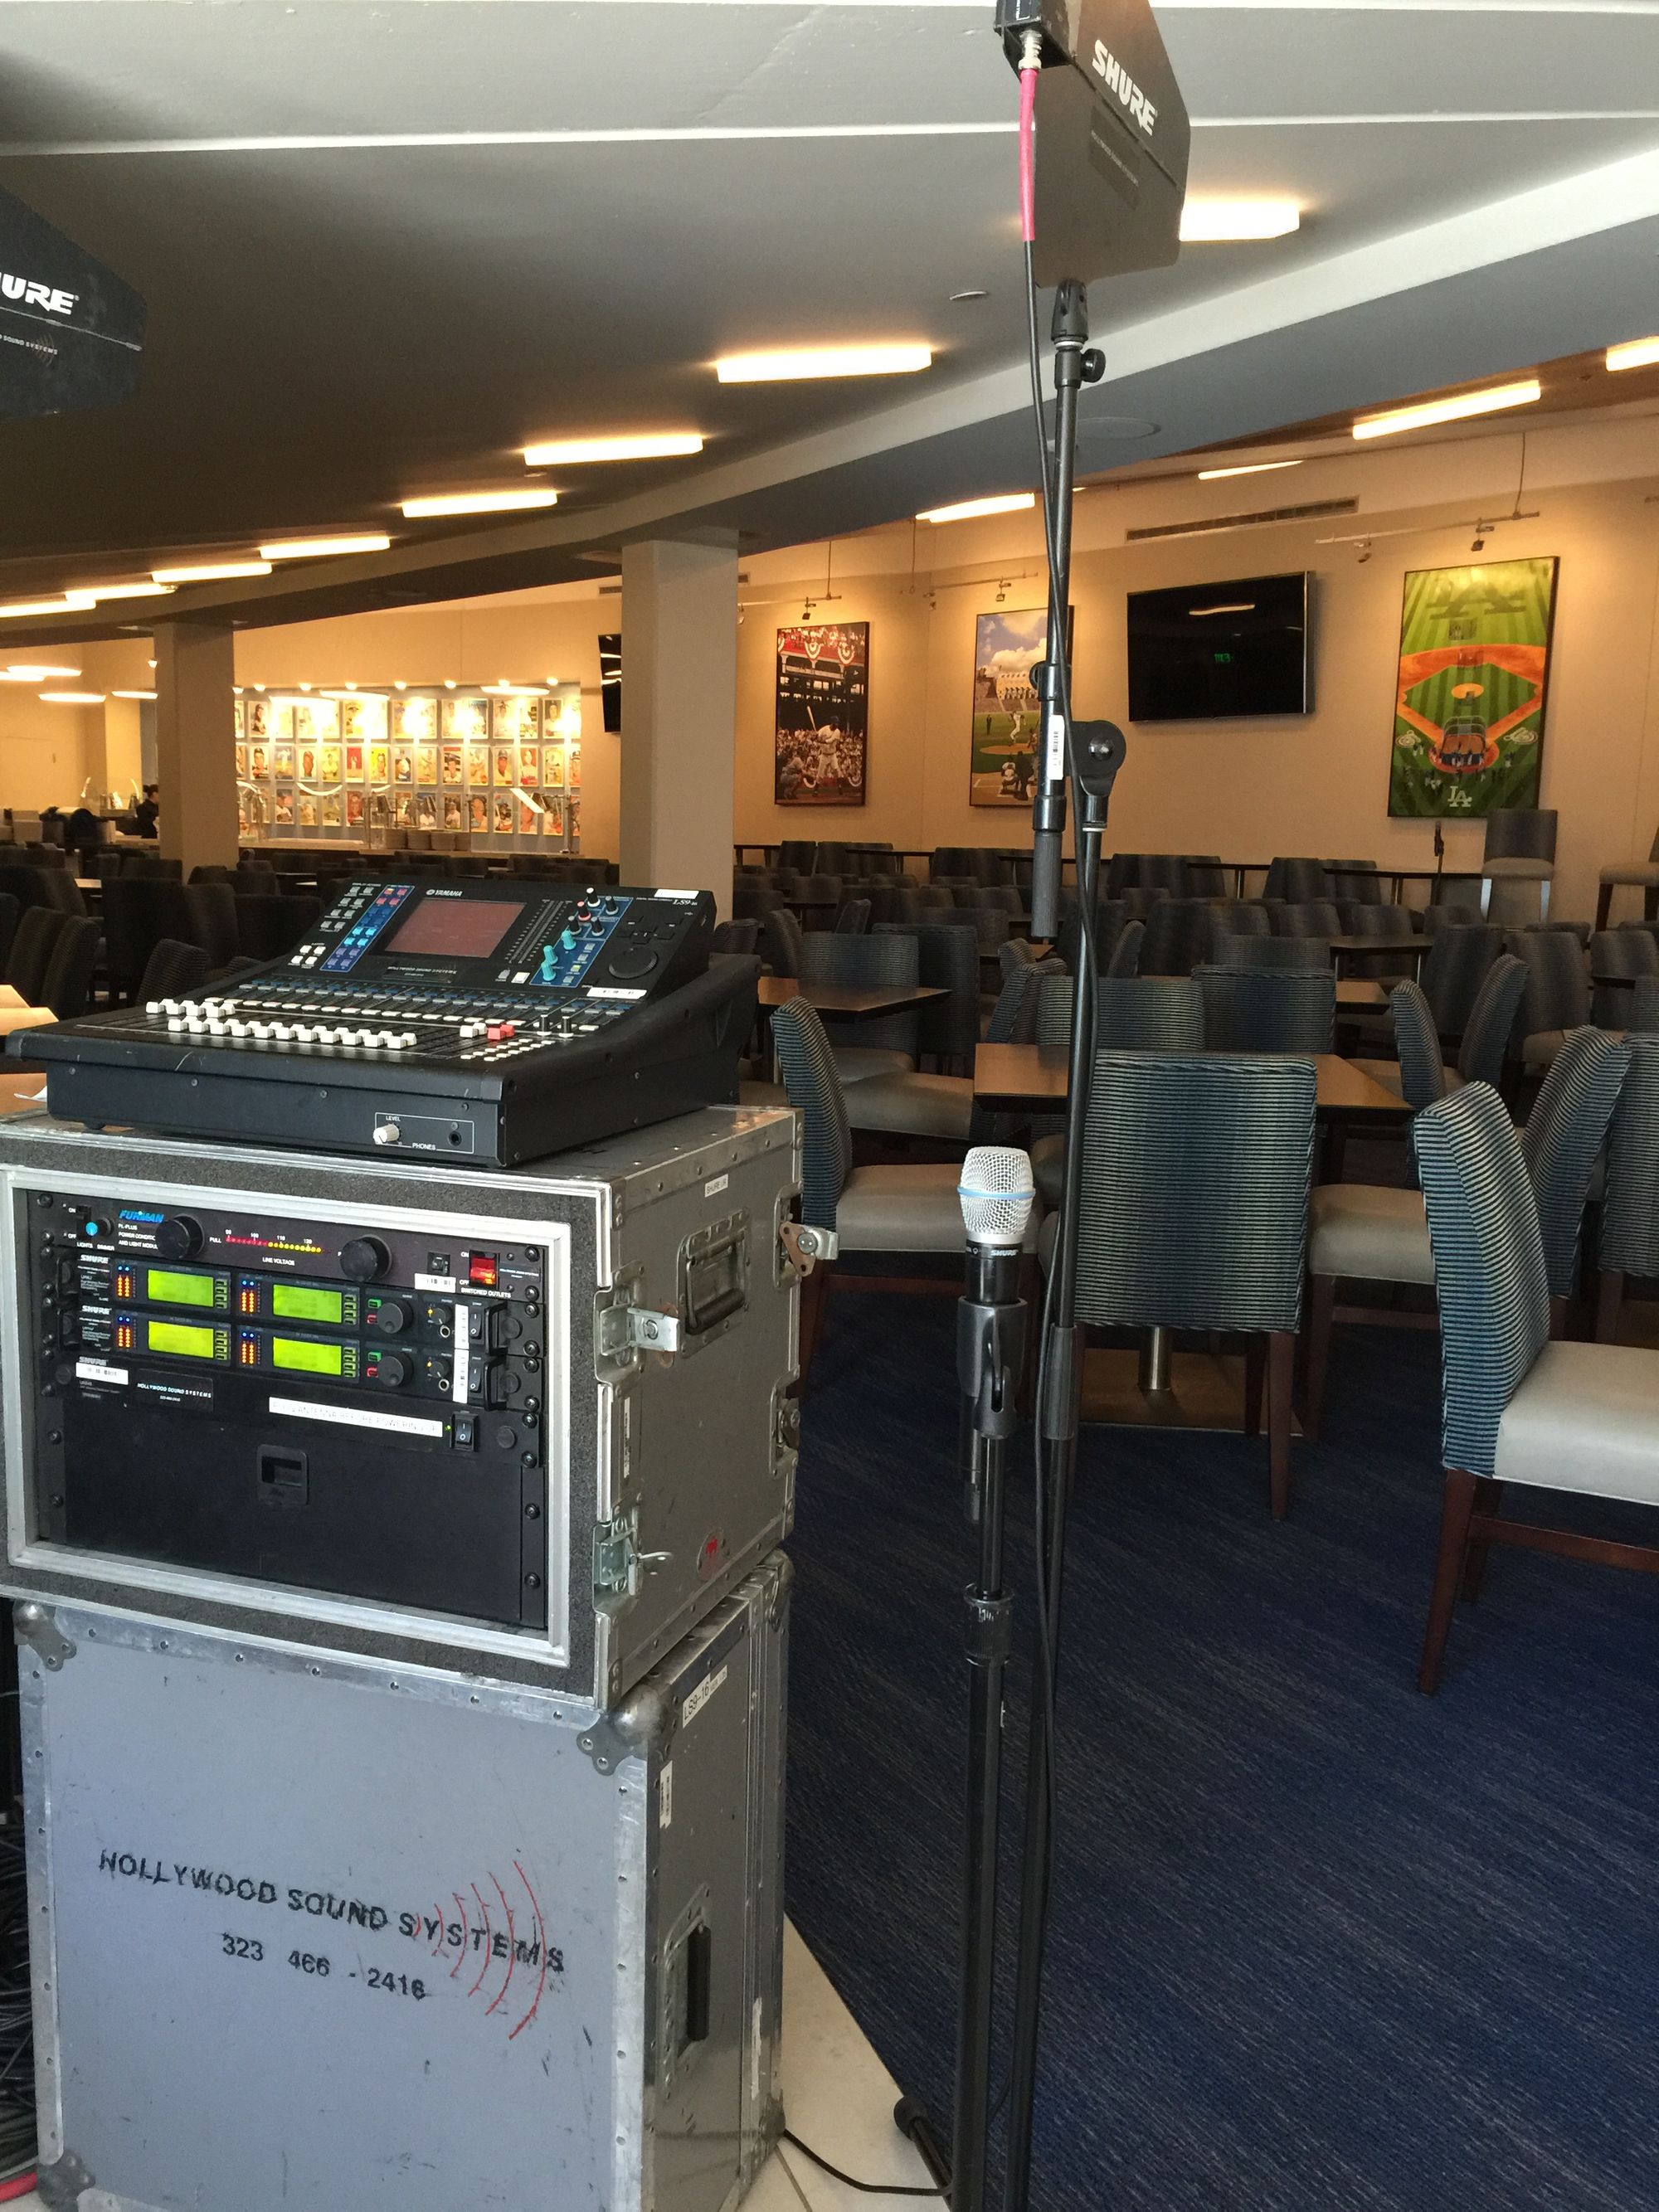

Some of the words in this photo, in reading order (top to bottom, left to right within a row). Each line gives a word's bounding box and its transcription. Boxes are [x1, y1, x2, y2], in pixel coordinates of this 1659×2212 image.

[1092, 39, 1156, 136] SHURE
[0, 272, 75, 315] URE
[26, 342, 58, 355] SYSTEMS
[1447, 785, 1472, 808] LA
[434, 888, 463, 897] YAMAHA
[119, 1209, 165, 1223] FURMAN
[80, 1254, 109, 1264] SHURE
[990, 1248, 1019, 1257] SHURE
[274, 1258, 295, 1266] VOLTAGE
[460, 1287, 488, 1296] SWITCHED
[488, 1290, 512, 1299] OUTLETS
[81, 1305, 110, 1315] SHURE
[137, 1382, 168, 1393] HOLLYWOOD
[167, 1386, 185, 1395] SOUND
[185, 1388, 212, 1399] SYSTEMS
[684, 1680, 710, 1721] LS9-16
[99, 1850, 277, 1903] HOLLYWOOD
[288, 1889, 388, 1931] SOUND
[399, 1912, 564, 1972] SYSTEMS
[221, 1932, 264, 1962] 323
[288, 1950, 330, 1977] 466
